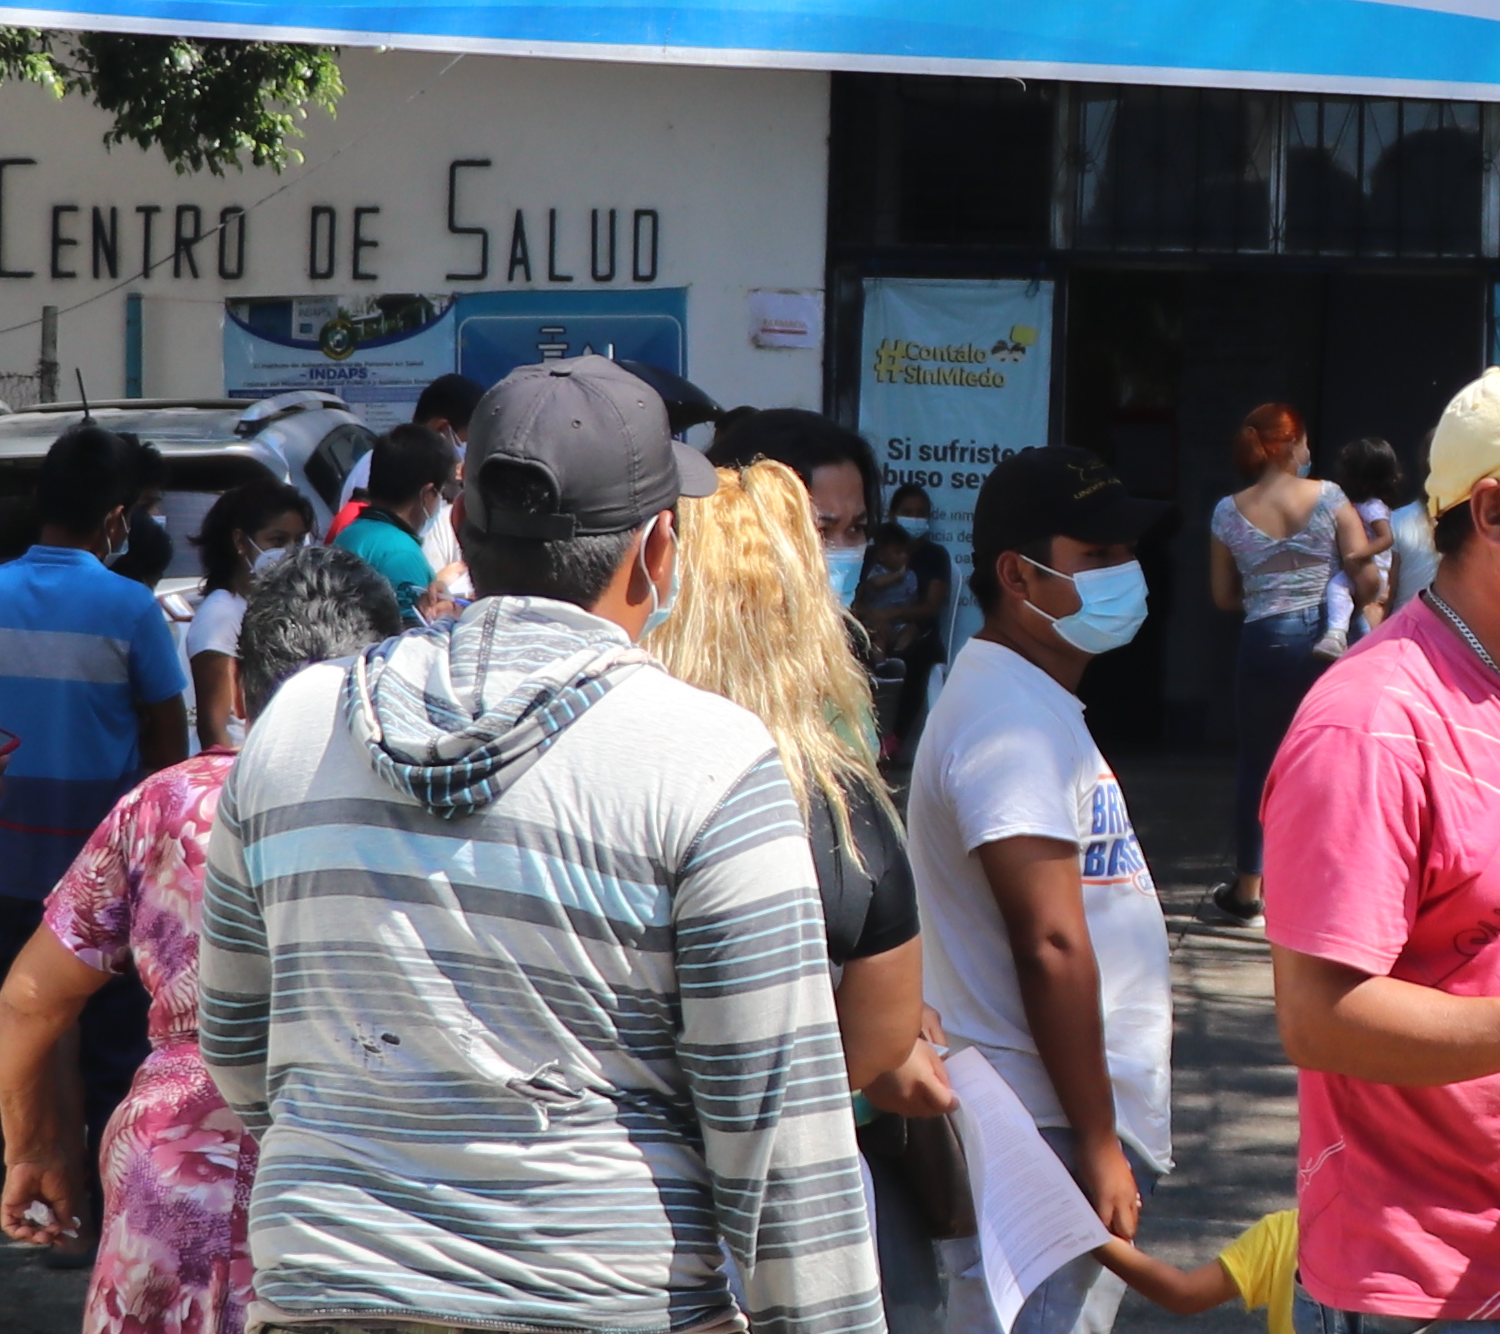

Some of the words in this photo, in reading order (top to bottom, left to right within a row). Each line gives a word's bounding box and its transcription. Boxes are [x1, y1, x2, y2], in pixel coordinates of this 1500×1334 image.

[308, 205, 381, 282] DE
[445, 158, 660, 283] SALUD
[309, 368, 369, 381] INDAPS
[887, 438, 911, 461] Si
[918, 438, 1015, 465] sufriste
[883, 463, 944, 489] buso
